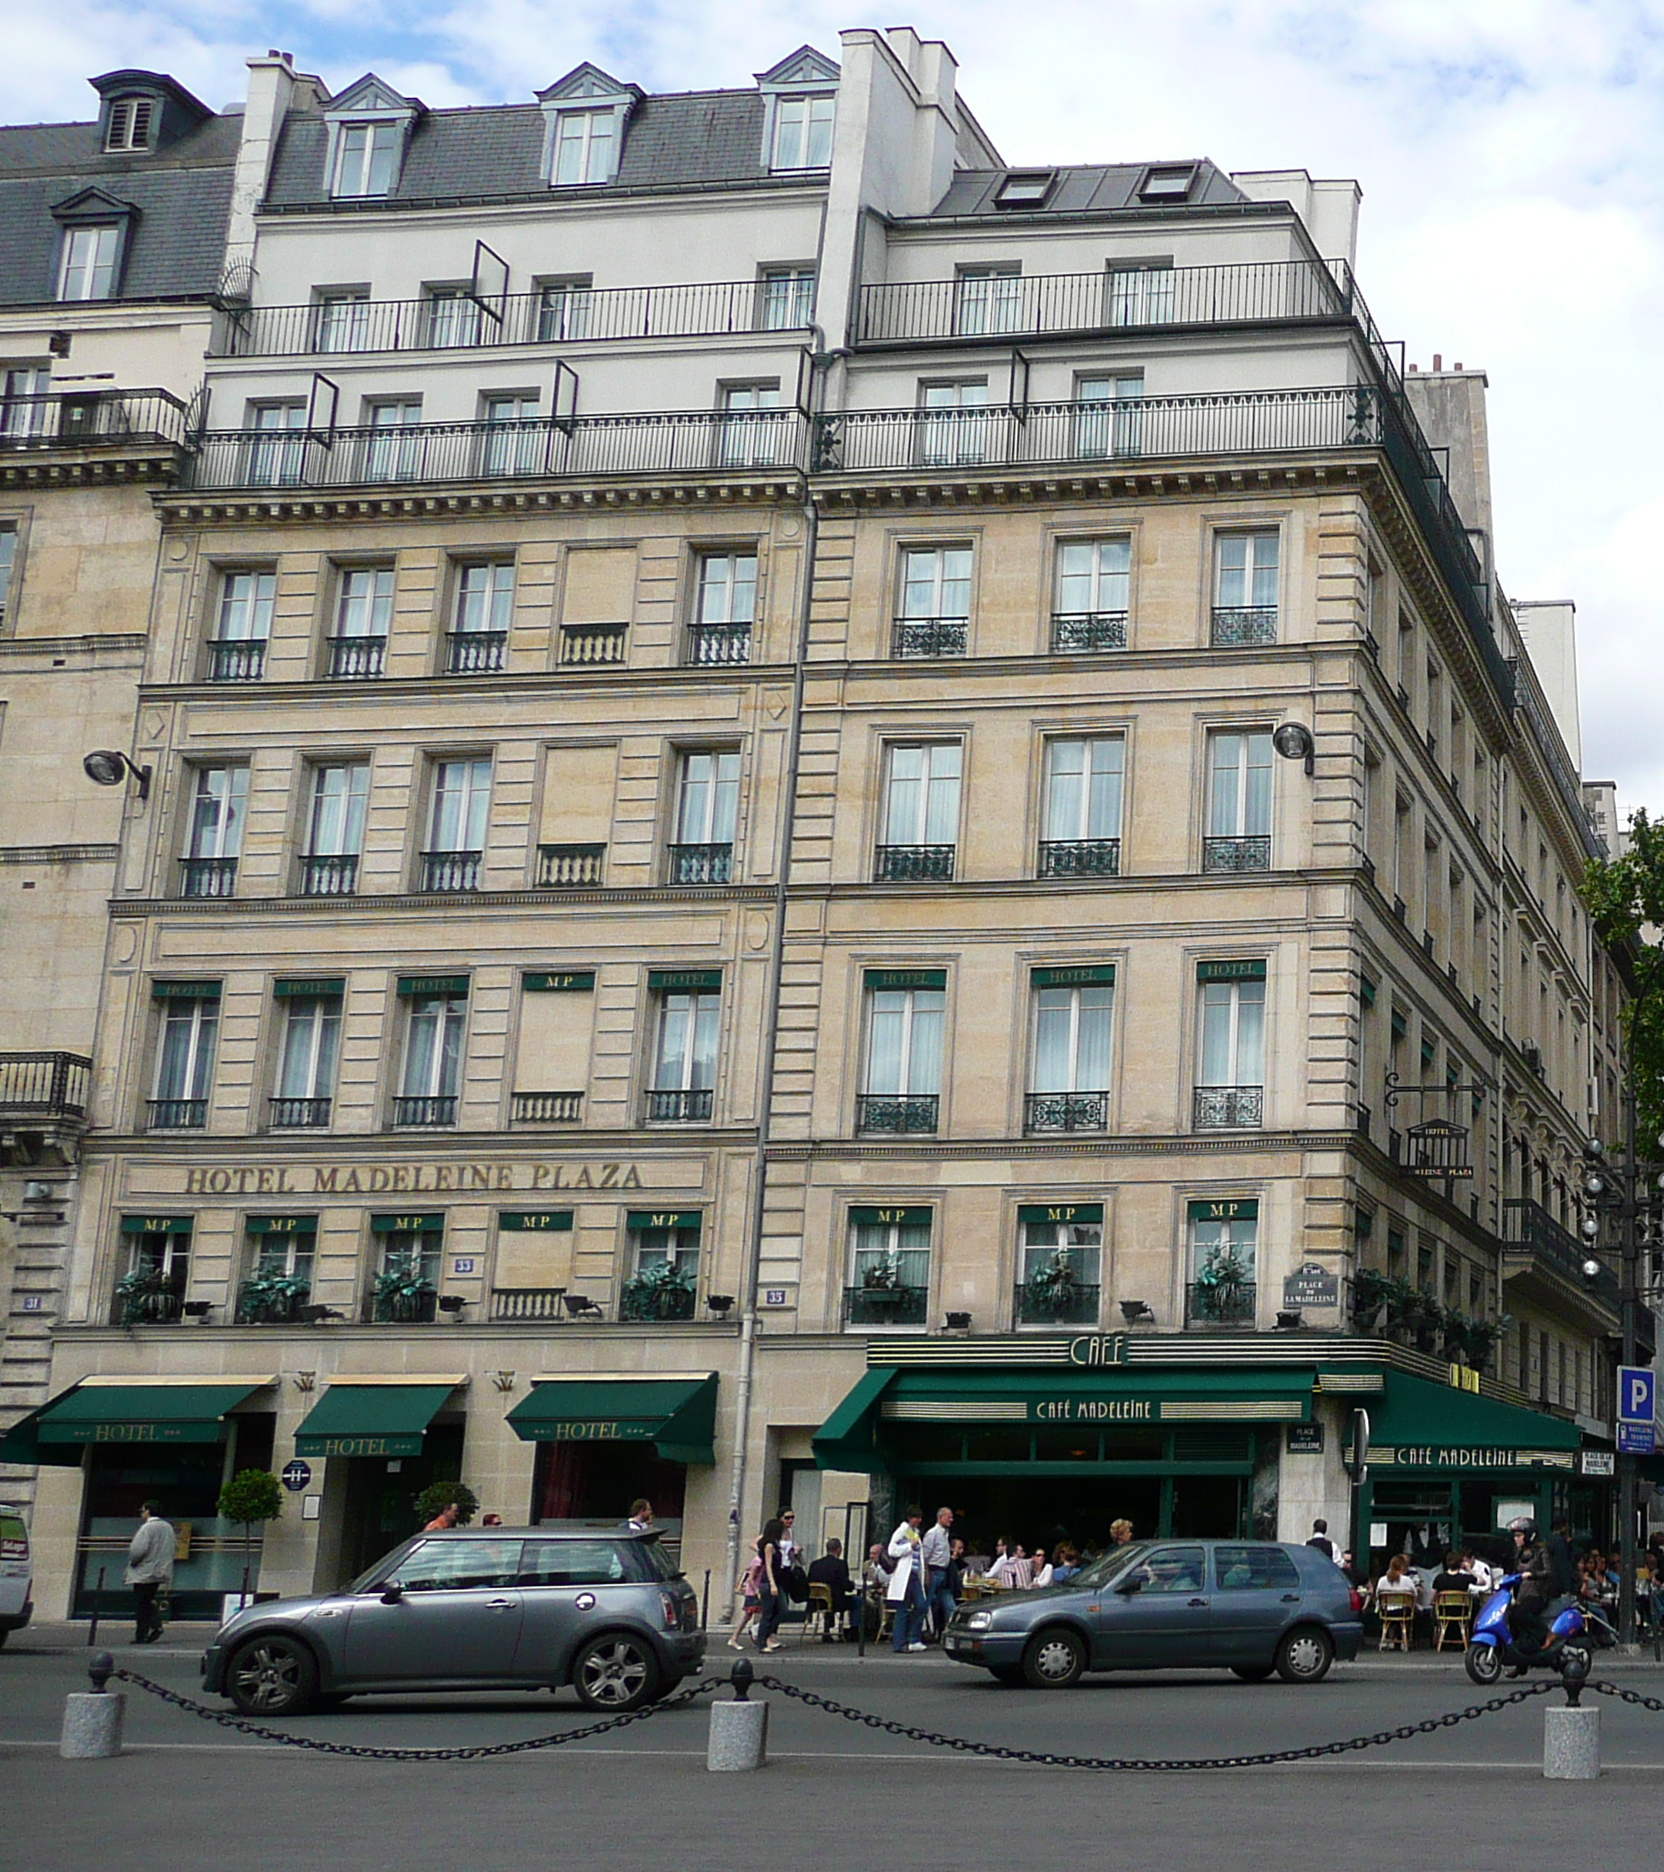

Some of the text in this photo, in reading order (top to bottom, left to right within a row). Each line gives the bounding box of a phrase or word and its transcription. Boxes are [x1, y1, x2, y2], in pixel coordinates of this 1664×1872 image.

[1049, 968, 1098, 983] HOTEL
[1206, 962, 1257, 977] HOTEL
[411, 979, 456, 992] HOTEL
[662, 973, 709, 986] HOTEL
[882, 971, 930, 985] HOTEL
[184, 1163, 644, 1193] HOTEL MADELEINE PLAZA
[457, 1260, 471, 1271] 33
[1298, 1281, 1323, 1289] PLACE
[25, 1298, 39, 1309] 31
[769, 1291, 784, 1303] 35
[1631, 1378, 1648, 1412] P
[1036, 1399, 1152, 1419] CAFÉ MADELEINE
[95, 1424, 161, 1443] HOTEL
[555, 1422, 622, 1440] HOTEL
[323, 1438, 391, 1457] HOTEL
[1397, 1446, 1514, 1466] CAFÉ MADELEINE
[291, 1469, 301, 1482] H
